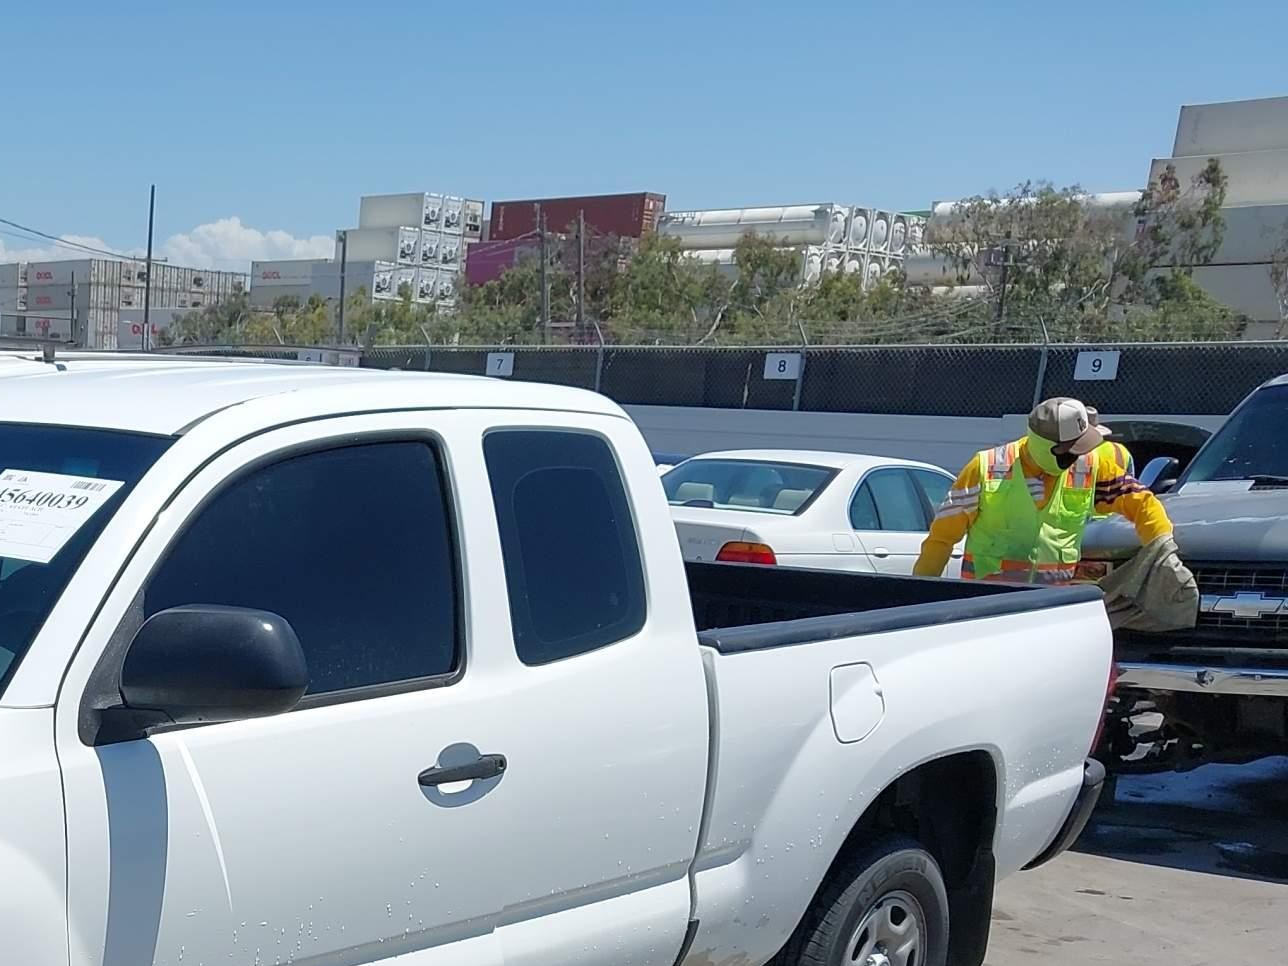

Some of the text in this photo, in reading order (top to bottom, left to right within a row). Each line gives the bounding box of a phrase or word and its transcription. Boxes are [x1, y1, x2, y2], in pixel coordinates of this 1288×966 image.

[496, 358, 504, 370] 7
[778, 359, 787, 373] 8
[1091, 358, 1102, 373] 9
